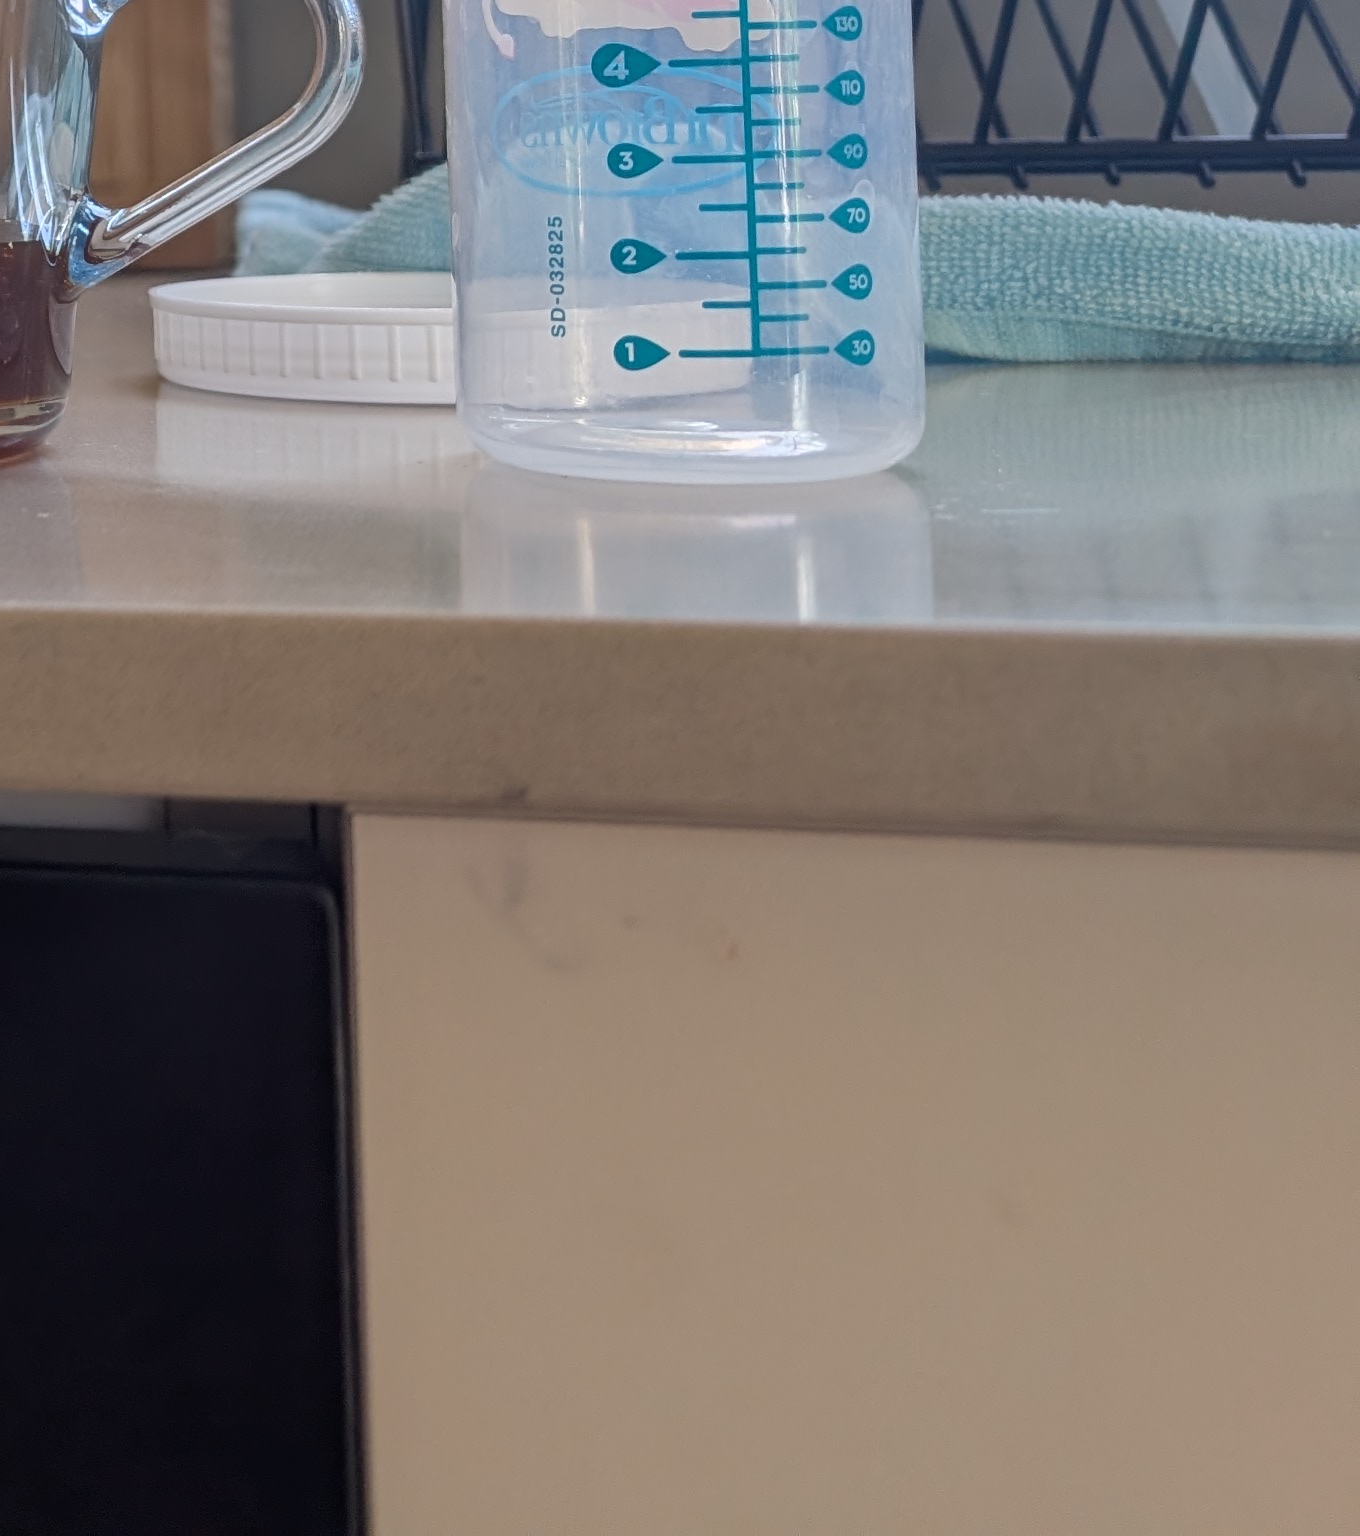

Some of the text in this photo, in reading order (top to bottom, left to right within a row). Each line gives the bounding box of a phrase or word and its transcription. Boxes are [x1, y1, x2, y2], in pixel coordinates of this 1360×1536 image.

[834, 16, 858, 32] 130
[603, 50, 630, 81] 4
[840, 79, 861, 95] 110
[843, 143, 864, 160] 90
[618, 151, 634, 171] 3
[847, 207, 866, 224] 70
[621, 245, 637, 265] 2
[547, 215, 567, 338] SD-032825
[848, 273, 868, 290] 50
[624, 342, 635, 363] 1
[851, 339, 872, 356] 30
